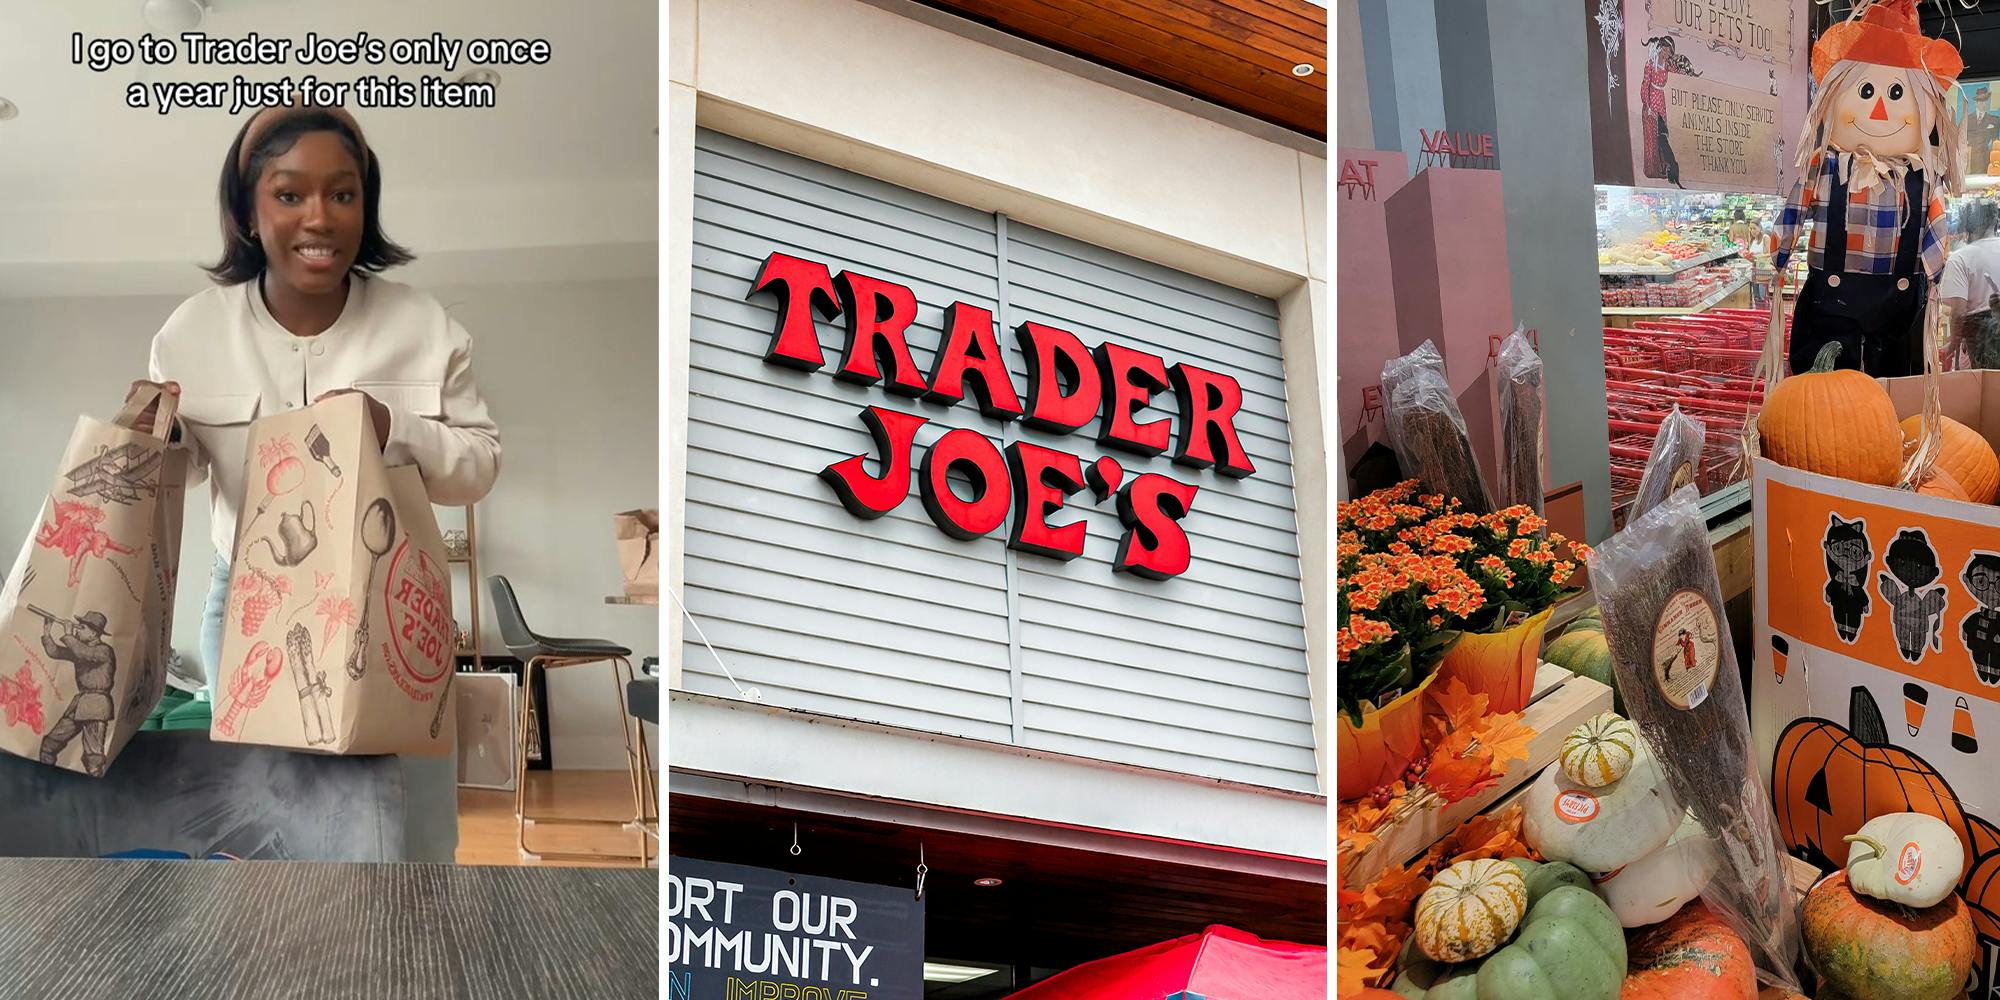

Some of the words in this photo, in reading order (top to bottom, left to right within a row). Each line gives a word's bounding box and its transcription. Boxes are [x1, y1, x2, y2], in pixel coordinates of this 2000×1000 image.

[1674, 0, 1702, 31] OUR
[1708, 8, 1743, 43] PETS
[1748, 22, 1773, 52] TOO!
[1671, 88, 1688, 108] BUT
[1691, 92, 1723, 115] PLEASE
[1724, 99, 1745, 118] ONLY
[1746, 105, 1774, 125] SERVICE
[1682, 111, 1722, 133] ANIMALS
[1725, 119, 1752, 139] INSIDE
[1419, 127, 1495, 158] VALUE
[1694, 134, 1714, 152] THE
[1716, 138, 1745, 156] STORE
[1338, 158, 1378, 186] AT
[1700, 154, 1730, 173] THANK
[745, 251, 1257, 479] TRADER
[818, 405, 1200, 581] JOE'S
[772, 890, 858, 940] OUR
